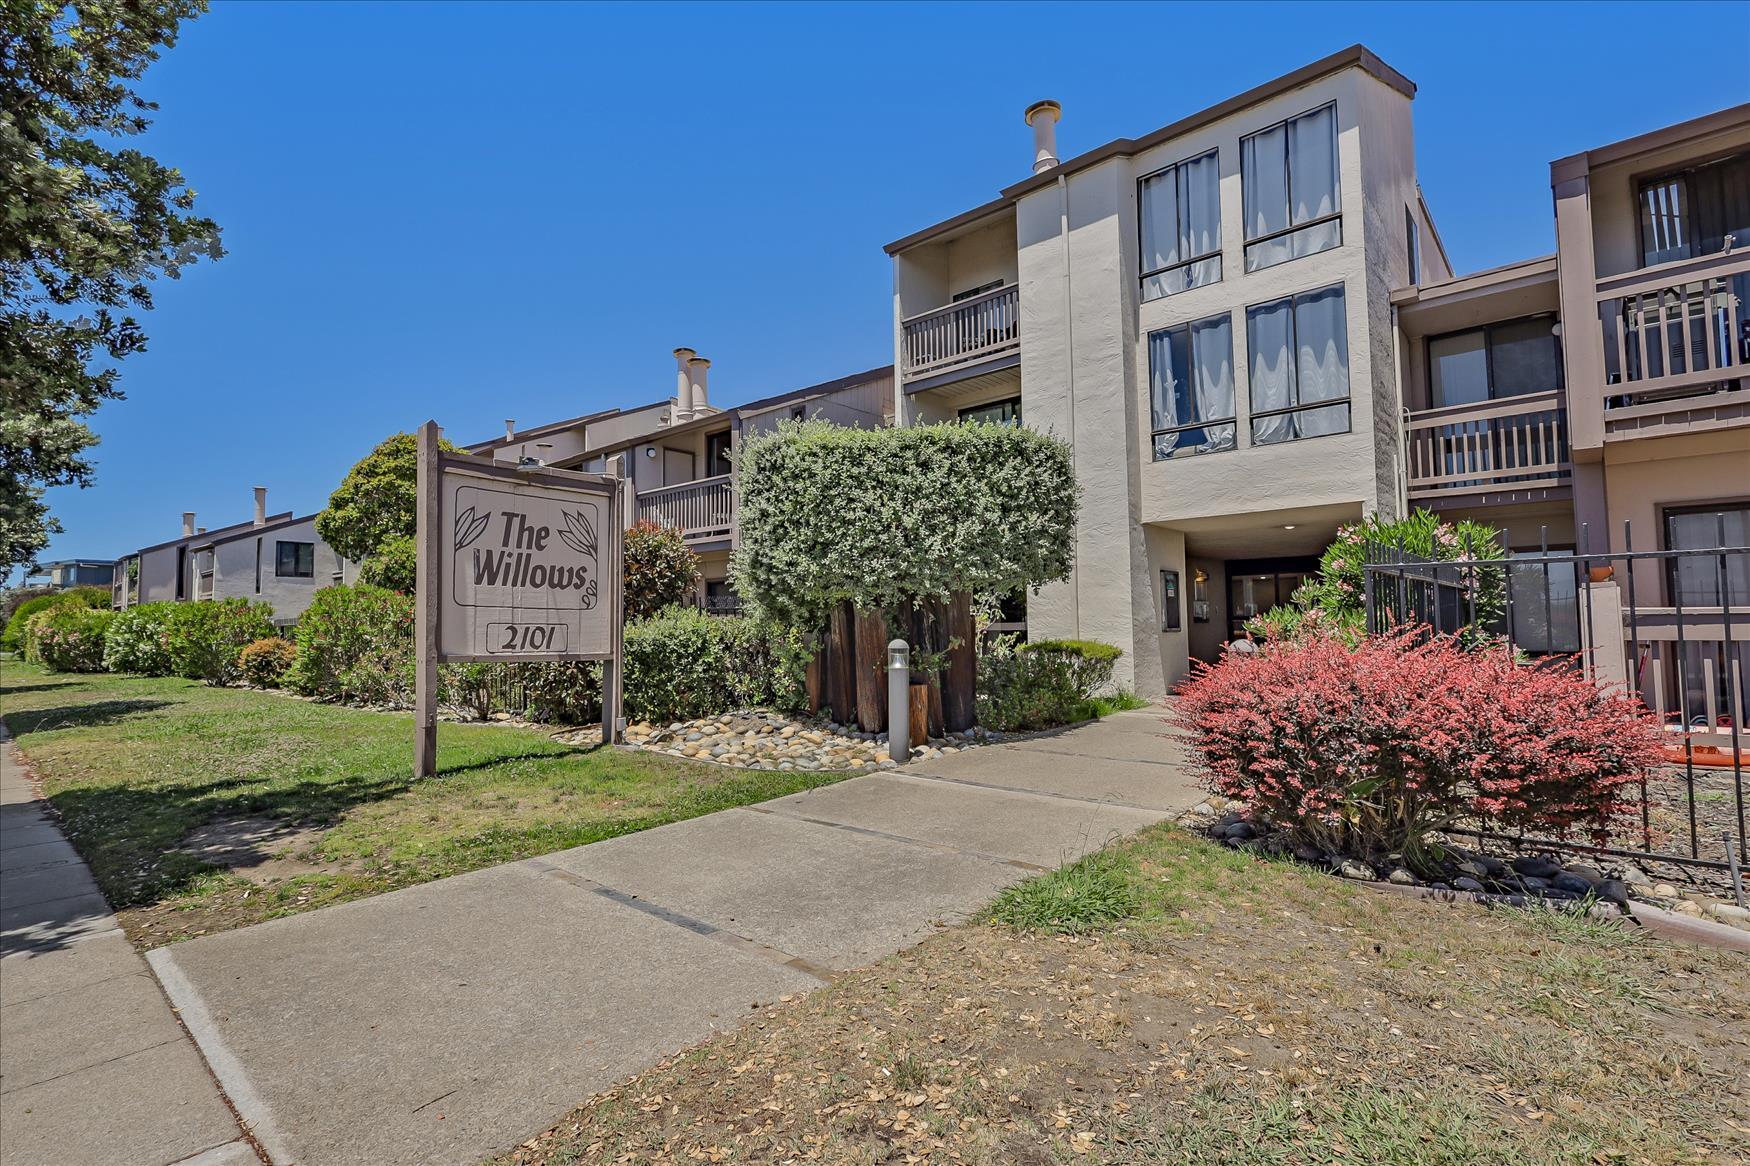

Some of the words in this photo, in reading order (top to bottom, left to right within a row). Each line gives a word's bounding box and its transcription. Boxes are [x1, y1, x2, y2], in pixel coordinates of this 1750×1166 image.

[501, 511, 550, 551] The
[473, 547, 588, 590] Willows
[501, 625, 556, 650] 2101
